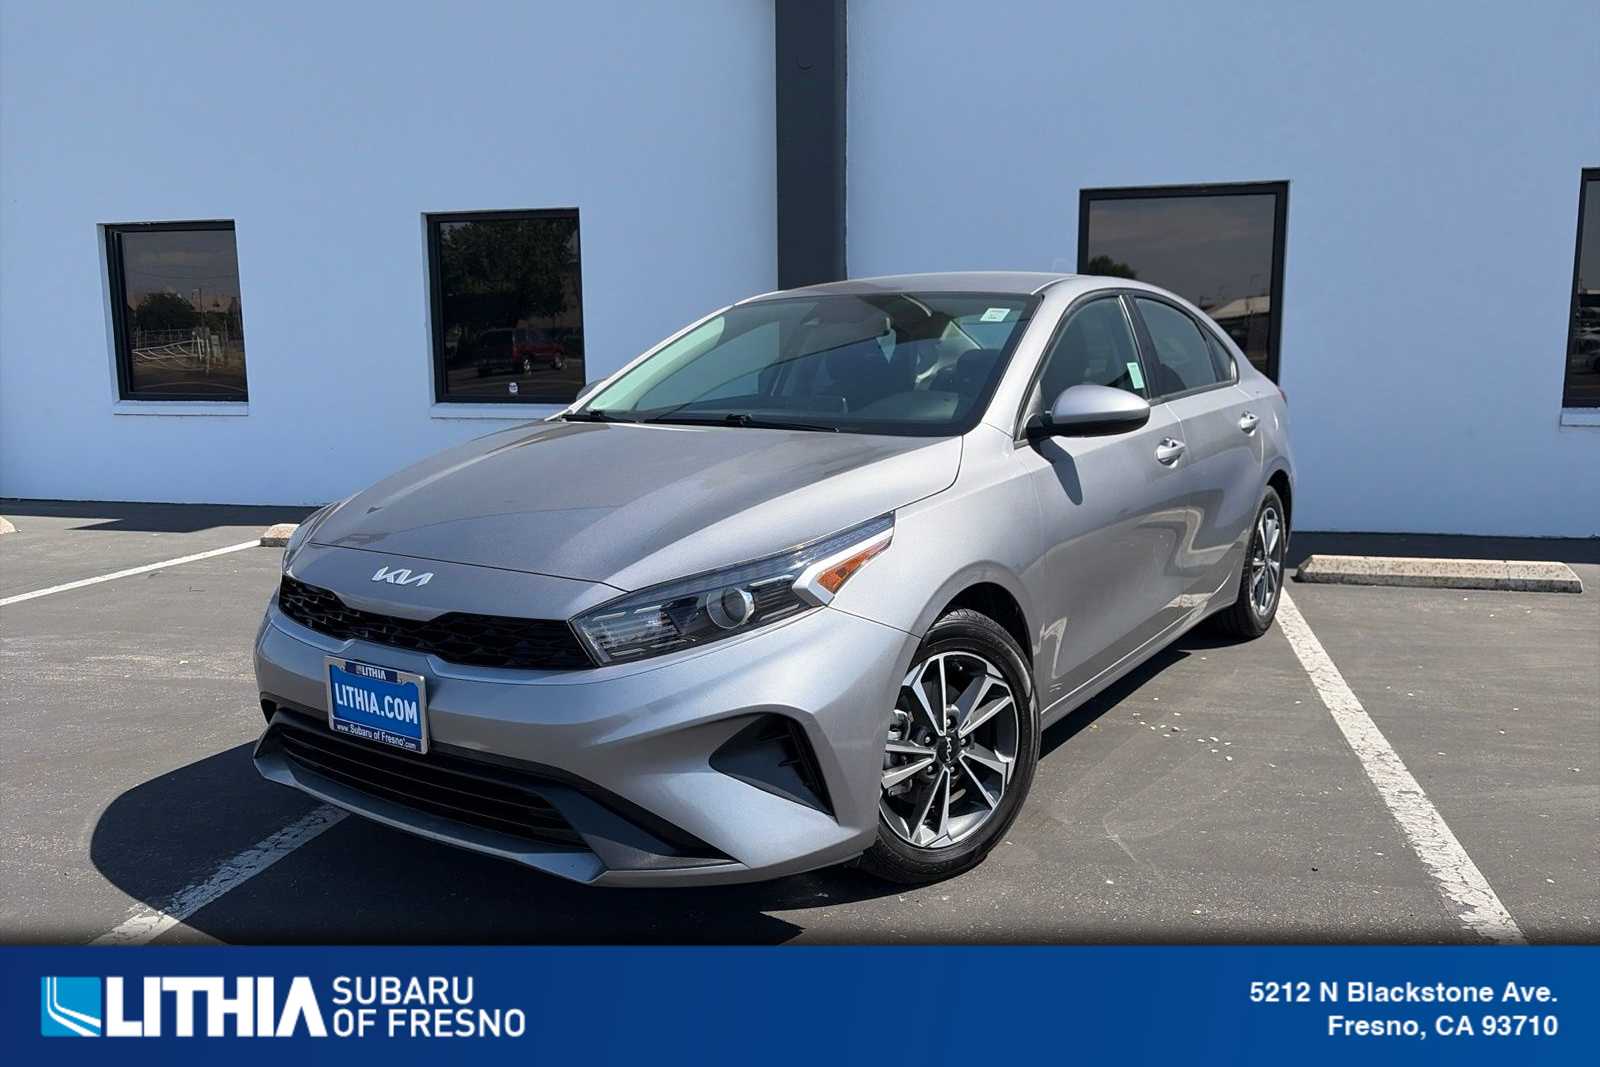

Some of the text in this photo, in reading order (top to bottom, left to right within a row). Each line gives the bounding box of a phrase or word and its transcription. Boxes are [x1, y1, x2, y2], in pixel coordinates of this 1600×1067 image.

[372, 566, 434, 587] KIA
[362, 665, 387, 680] LITHIA
[334, 682, 418, 725] LITHIA.COM
[350, 723, 373, 738] Subaru
[373, 730, 380, 740] of
